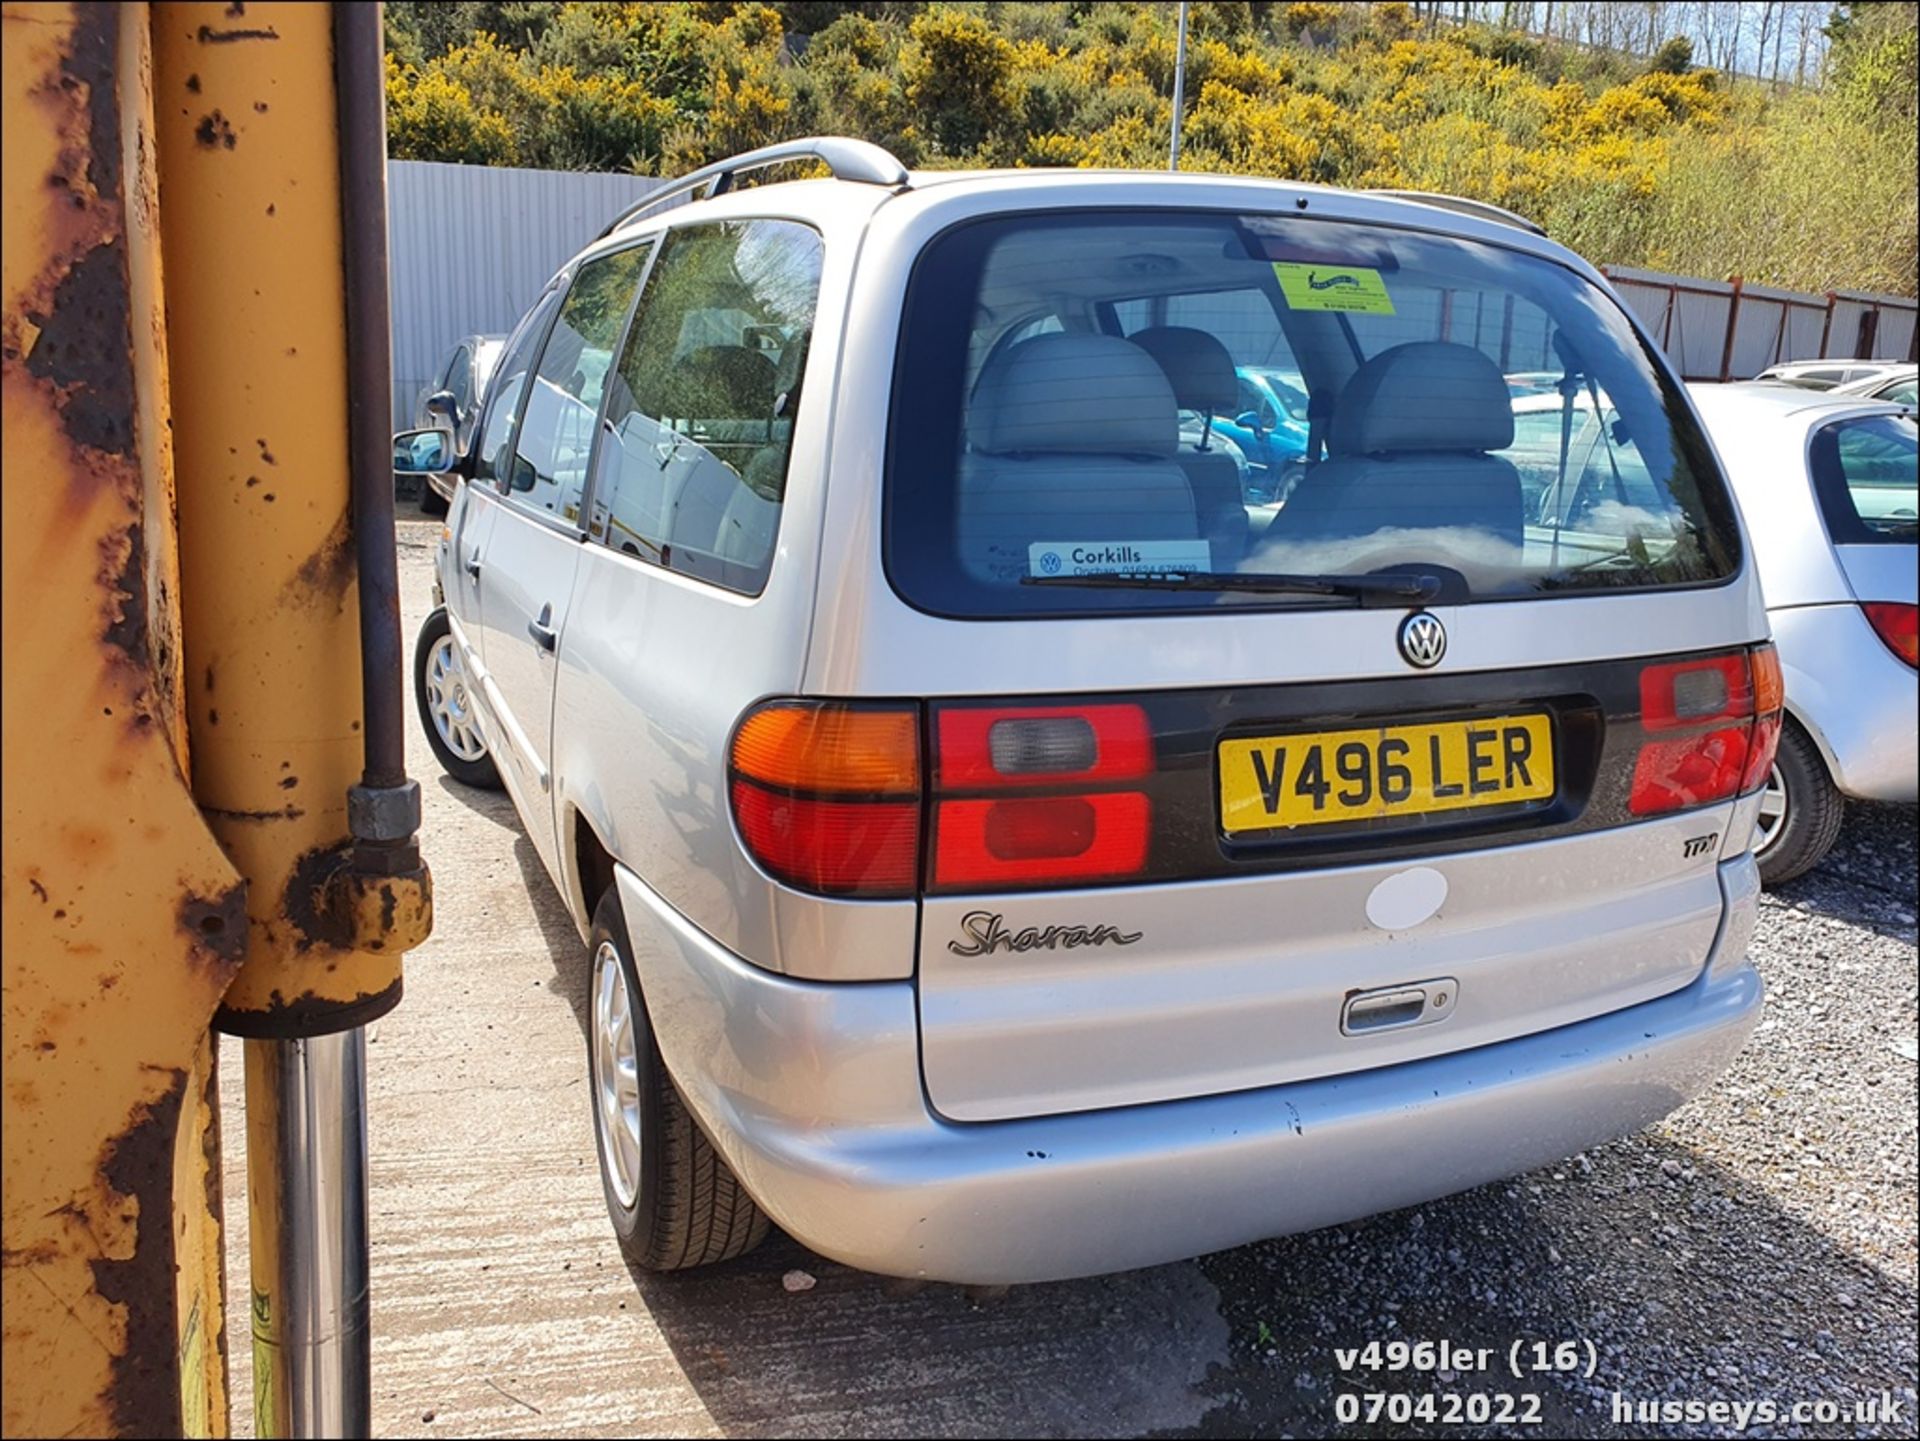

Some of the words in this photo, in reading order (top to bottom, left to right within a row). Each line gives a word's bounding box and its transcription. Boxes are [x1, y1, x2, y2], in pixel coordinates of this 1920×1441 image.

[1072, 546, 1142, 565] Corkills
[1250, 737, 1412, 815] V496
[1430, 726, 1534, 799] LER
[948, 910, 1144, 958] Sharan
